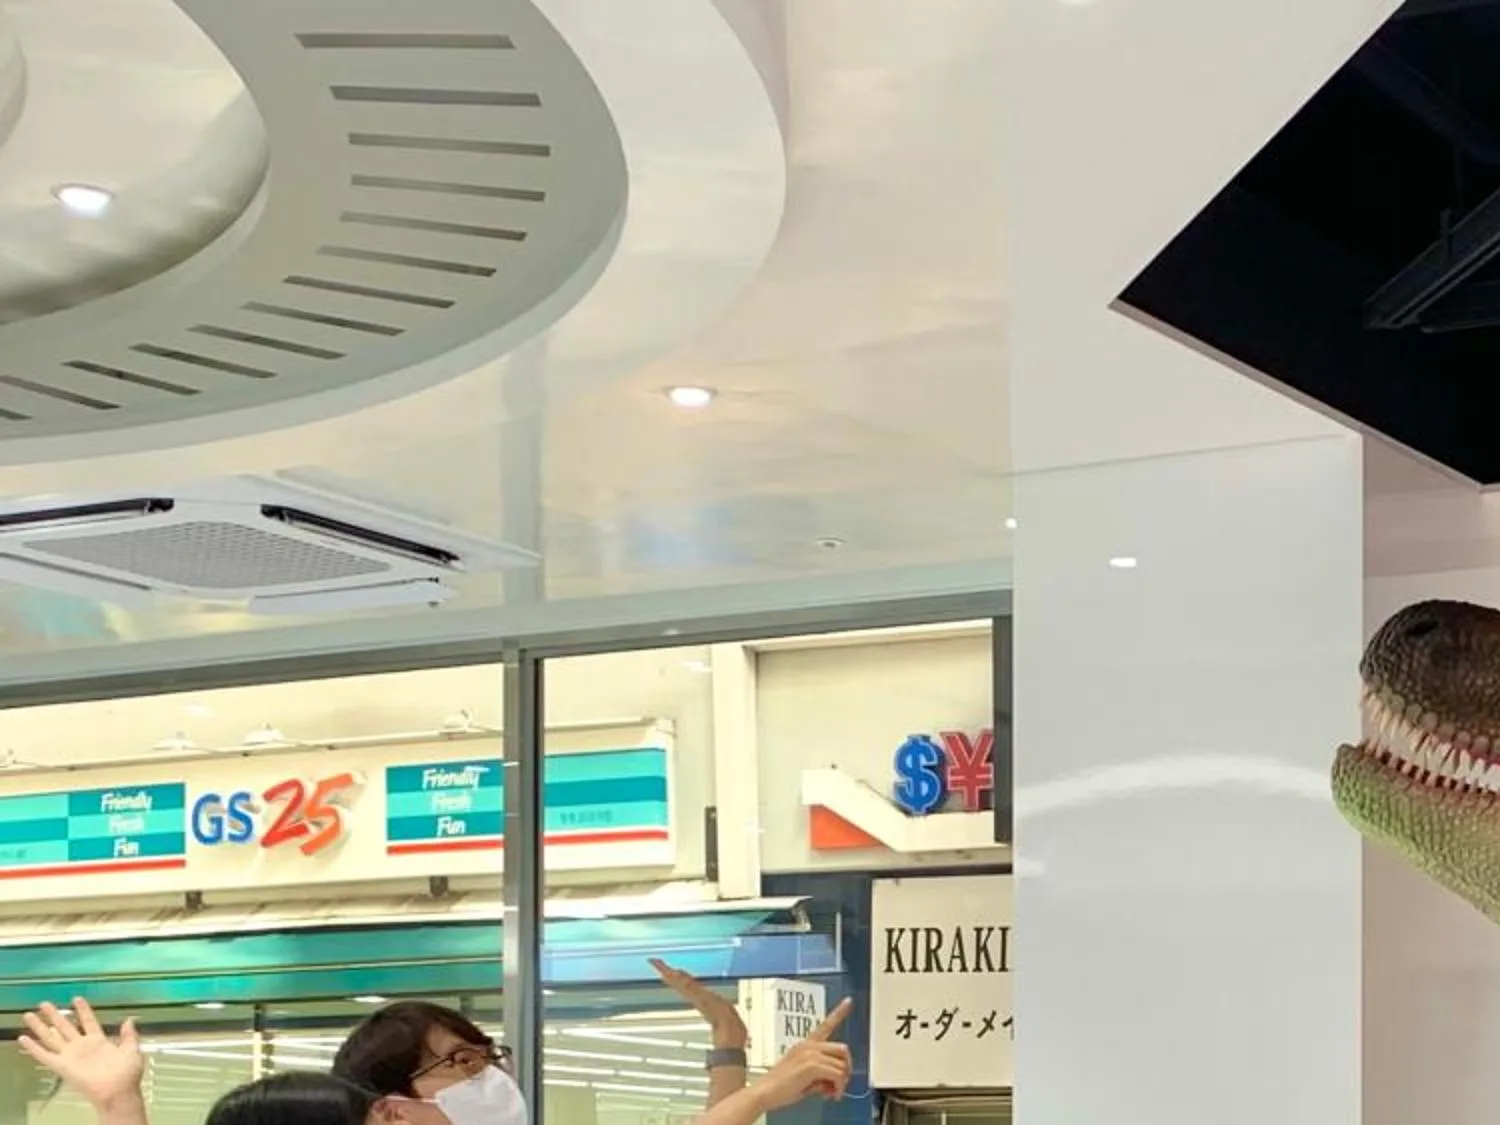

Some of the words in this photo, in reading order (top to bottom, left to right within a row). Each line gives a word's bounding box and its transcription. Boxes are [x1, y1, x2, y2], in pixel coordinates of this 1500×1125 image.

[422, 766, 480, 790] Friendly
[191, 773, 353, 856] GS25
[436, 815, 467, 838] Fun
[777, 988, 816, 1015] KIRA
[784, 1013, 823, 1037] KIR
